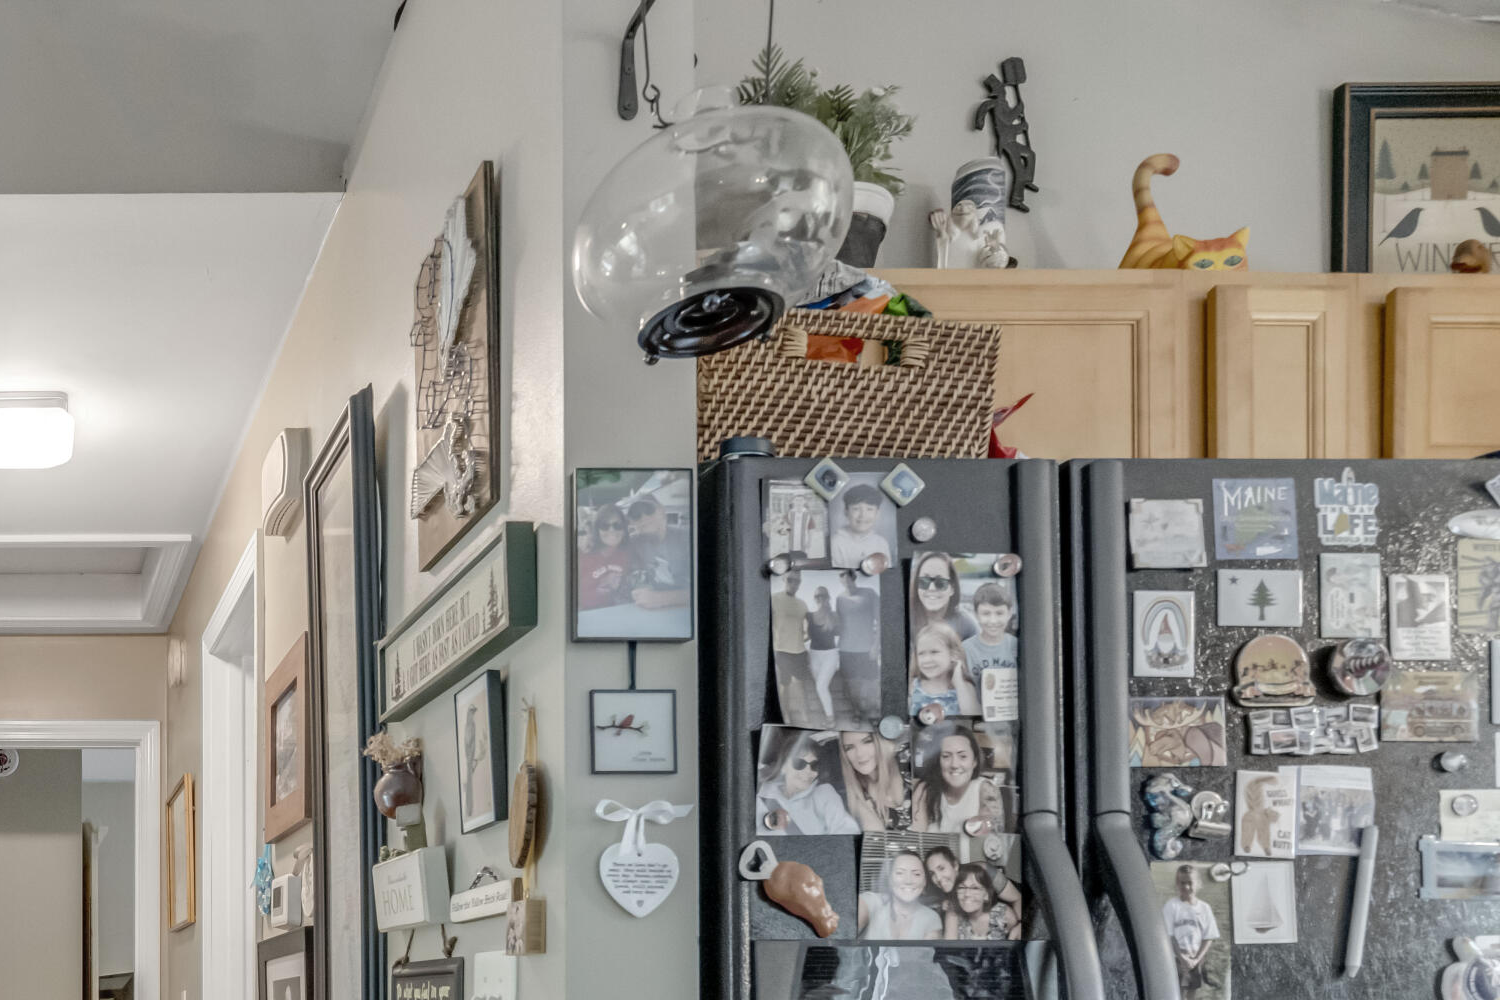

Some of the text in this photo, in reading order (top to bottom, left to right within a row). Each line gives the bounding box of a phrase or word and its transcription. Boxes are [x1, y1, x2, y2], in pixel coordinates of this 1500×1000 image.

[1395, 241, 1500, 273] WINR
[1222, 481, 1288, 517] MAINE
[1318, 479, 1378, 506] Maine
[445, 600, 459, 632] HERE
[460, 589, 470, 622] BUT
[381, 884, 415, 917] HOME
